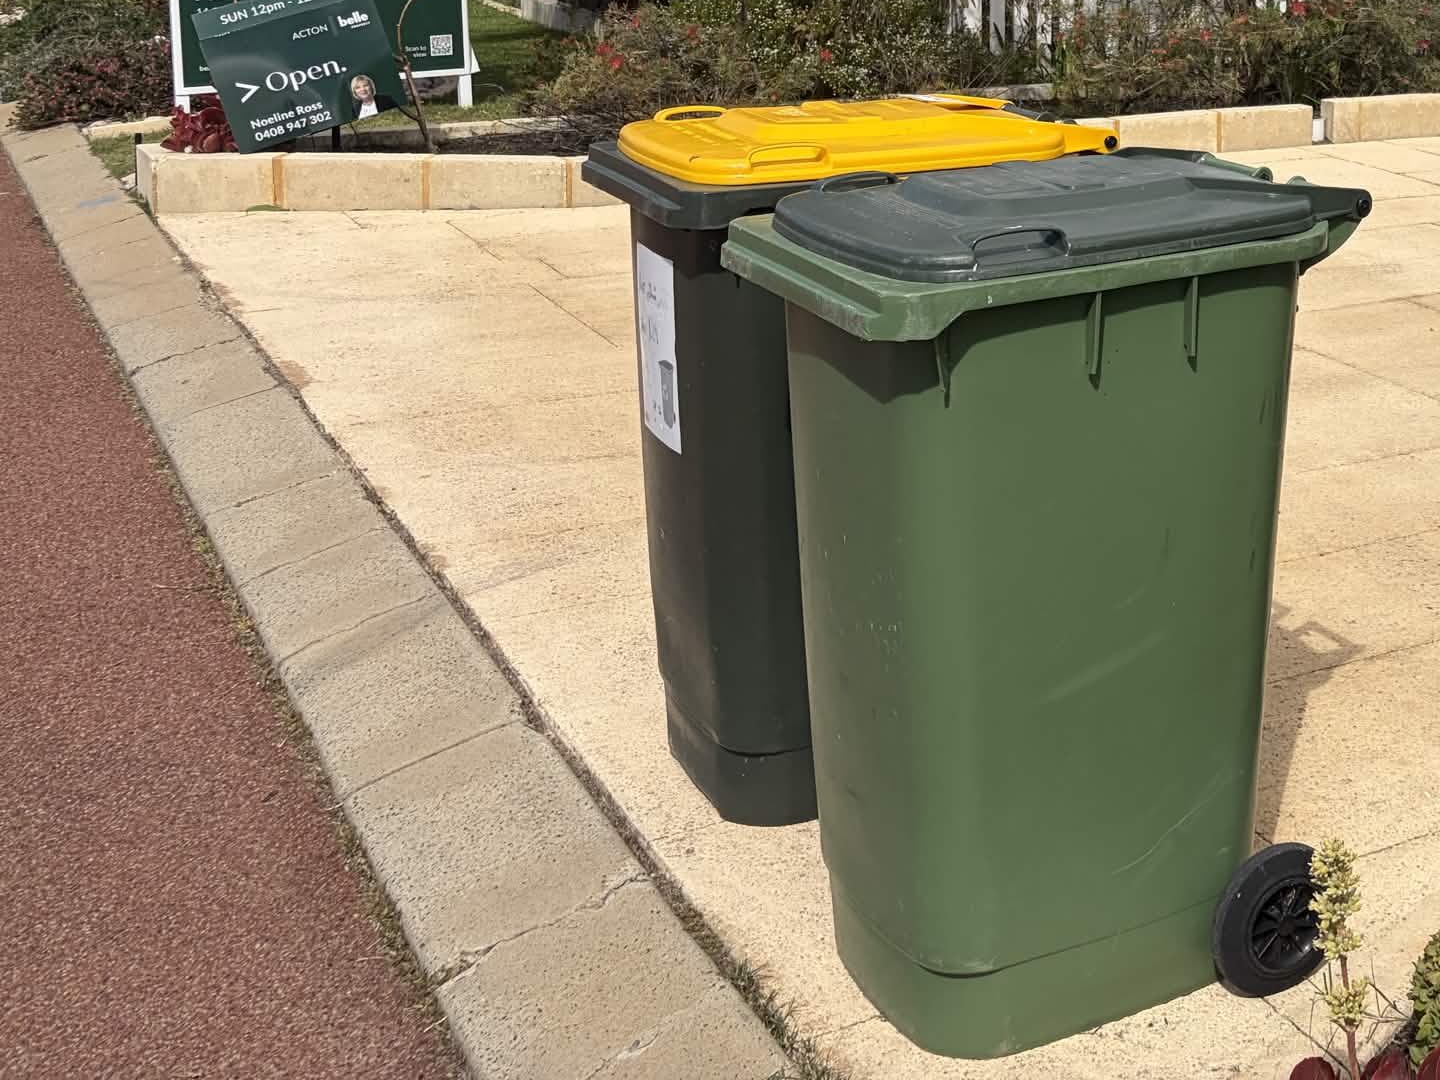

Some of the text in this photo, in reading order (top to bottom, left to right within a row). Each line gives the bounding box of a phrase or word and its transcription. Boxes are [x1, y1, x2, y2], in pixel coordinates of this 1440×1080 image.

[219, 9, 249, 25] SUN
[250, 0, 286, 17] 12pm
[337, 10, 369, 28] belle
[292, 23, 329, 41] ACTON
[265, 60, 348, 92] Open.
[250, 101, 324, 130] Noeline Ross
[255, 110, 333, 142] 0408 947 302
